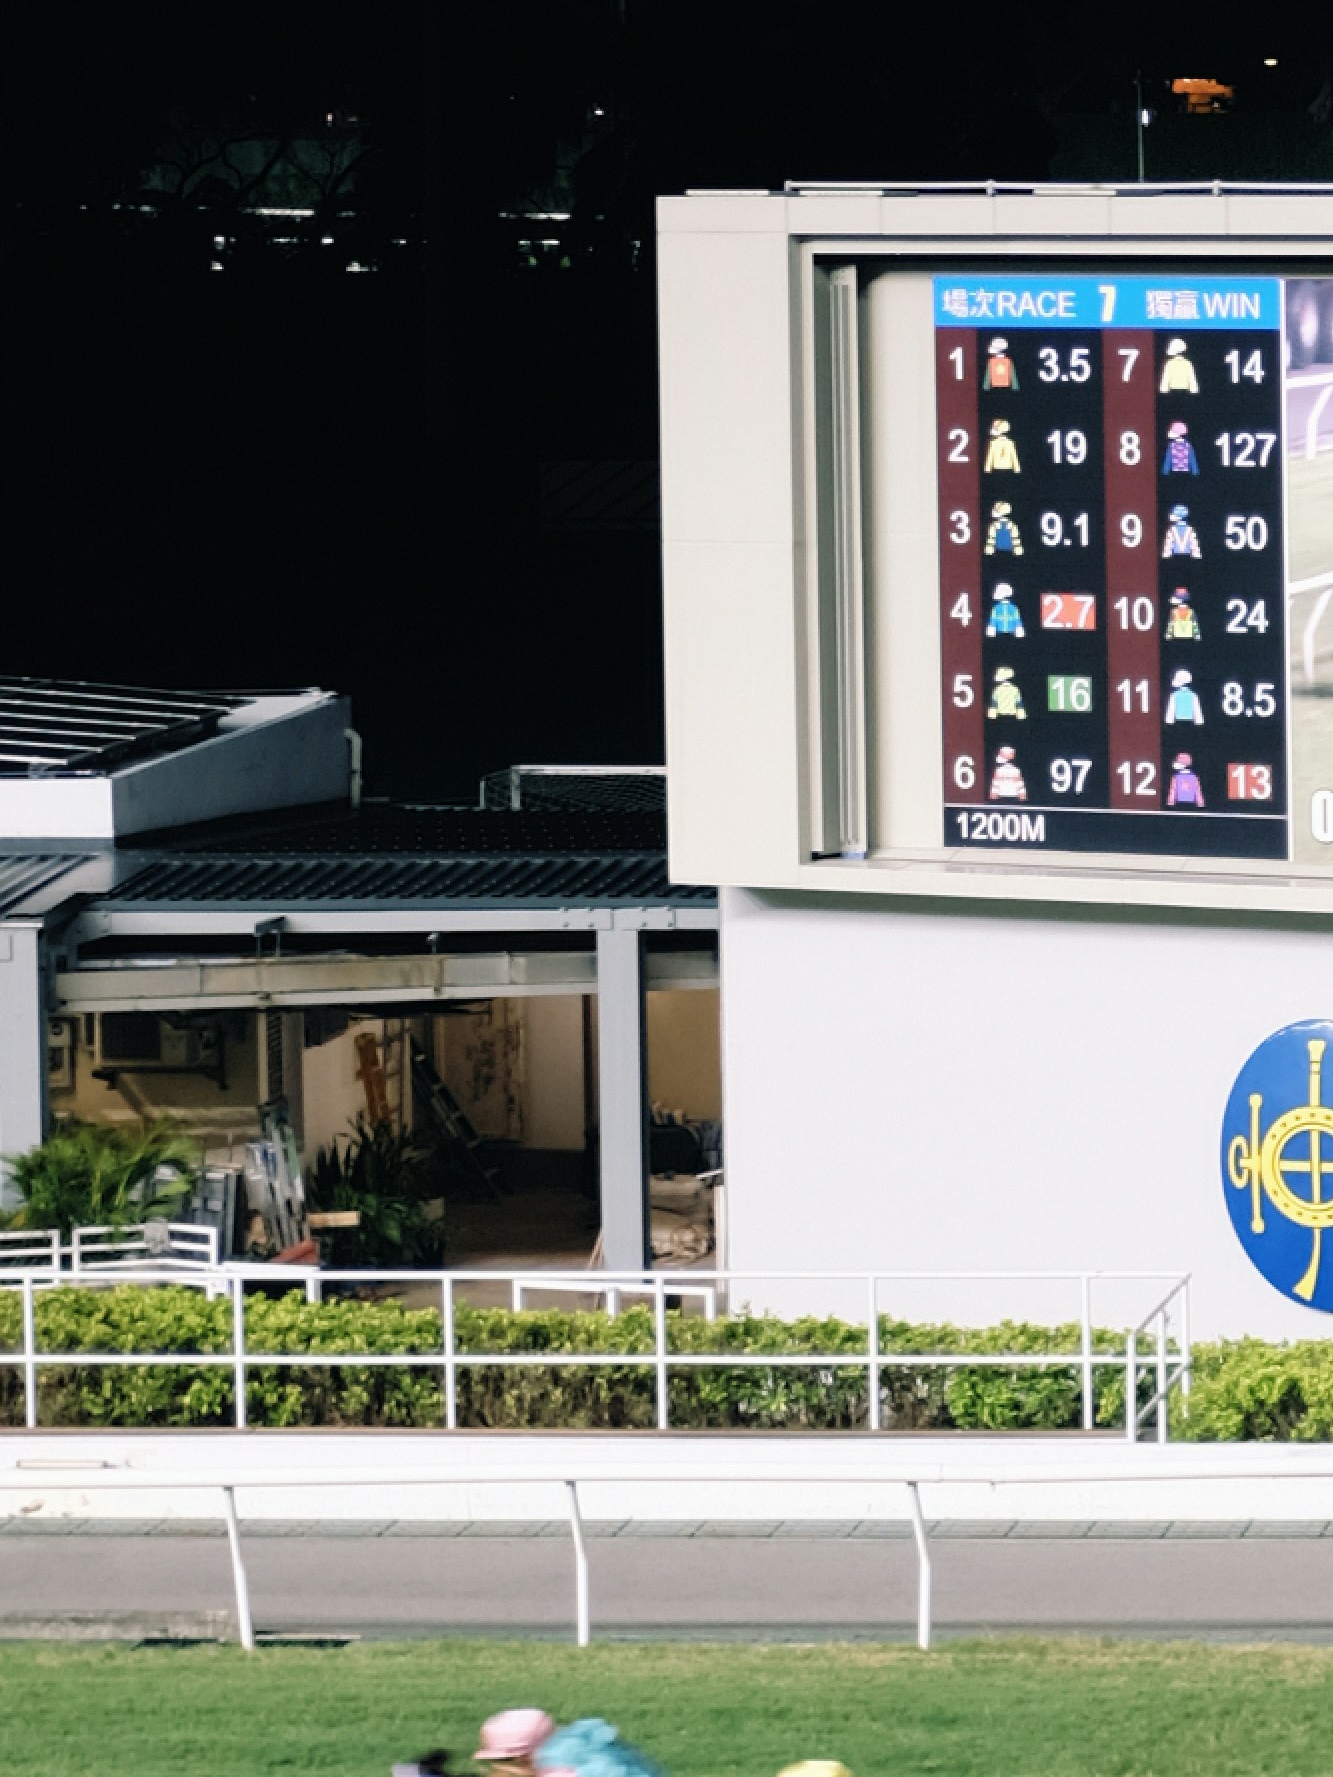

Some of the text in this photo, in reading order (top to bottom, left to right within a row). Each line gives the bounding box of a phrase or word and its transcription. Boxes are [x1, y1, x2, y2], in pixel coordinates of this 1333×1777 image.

[996, 290, 1075, 318] RACE
[1202, 292, 1261, 320] WIN
[949, 346, 1265, 384] 1 3.5 7 14
[947, 428, 1277, 468] 2 19 8 127
[949, 510, 1269, 552] 3 9.1 9 50
[949, 592, 1269, 634] 4 2.7 10 24
[953, 674, 1277, 718] 5 16 11 8.5
[953, 754, 1271, 800] 6 97 12 13
[957, 813, 1045, 842] 1200M
